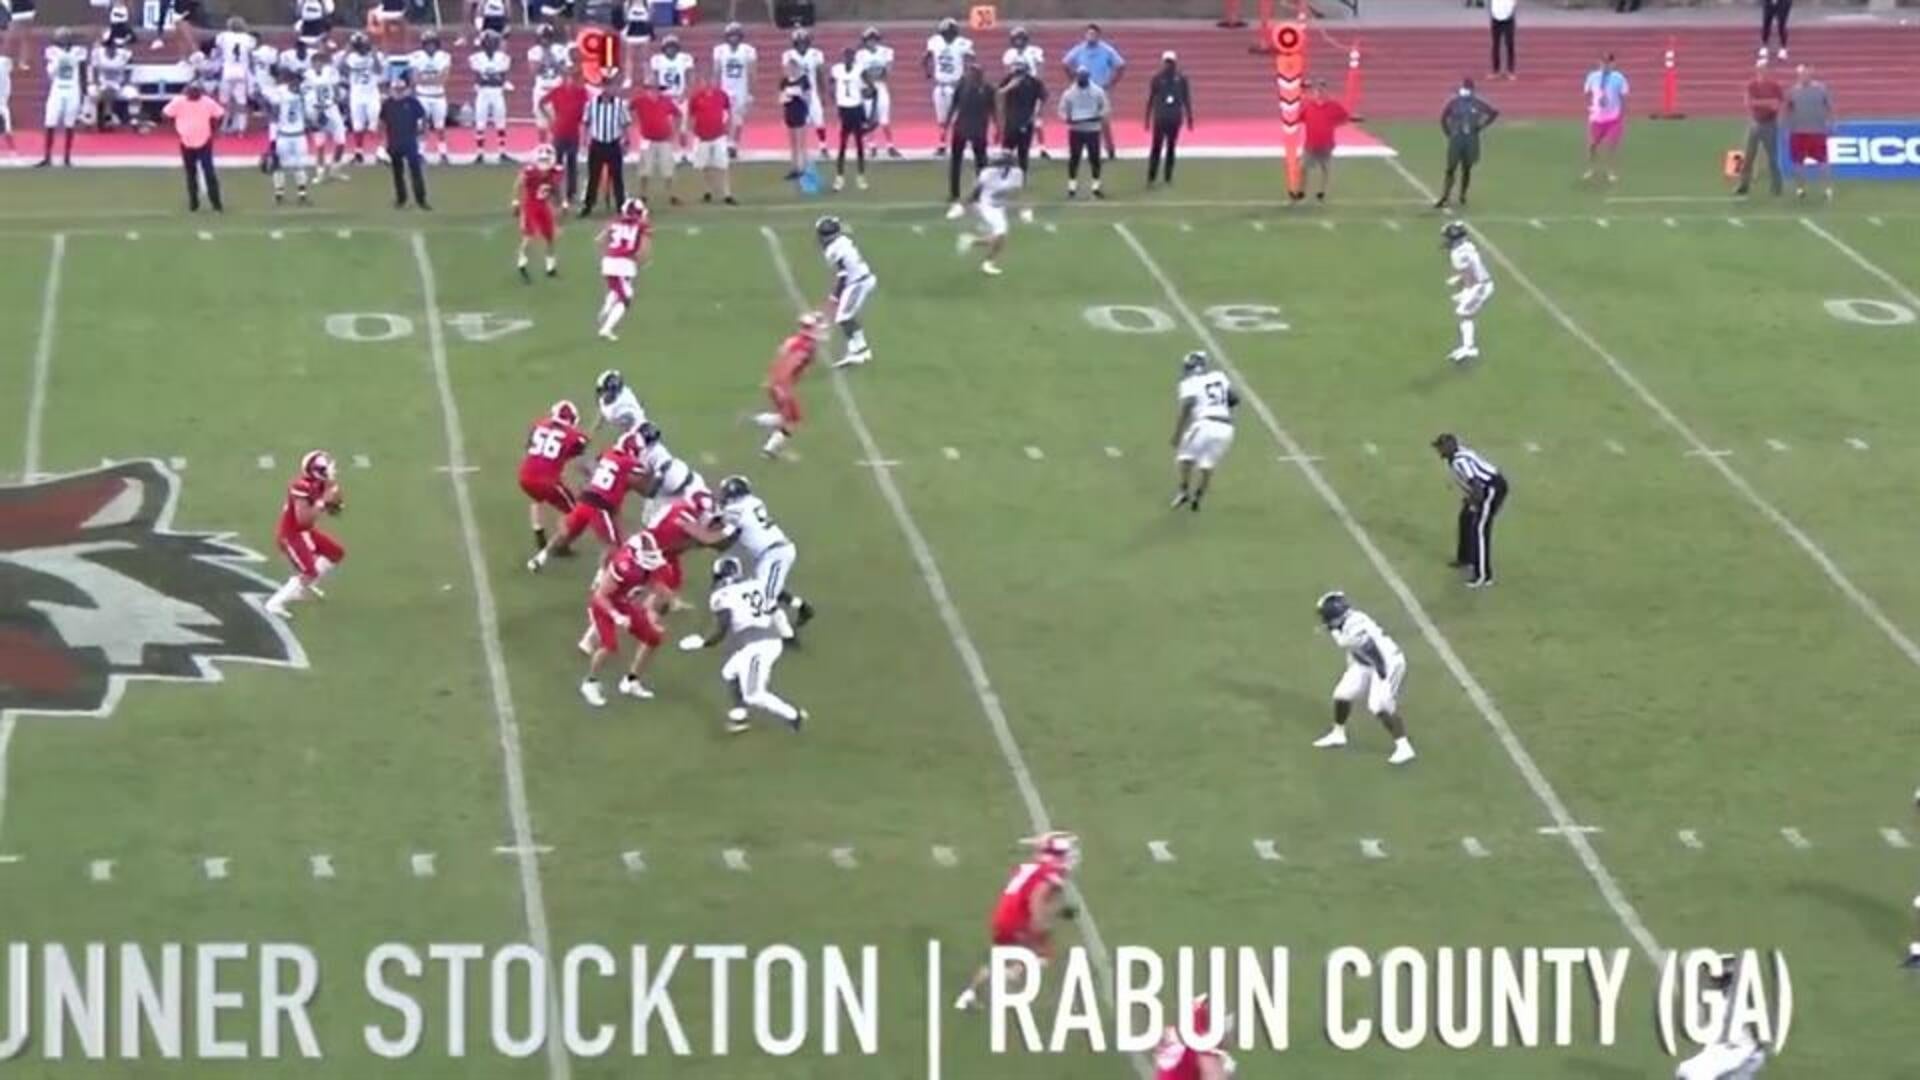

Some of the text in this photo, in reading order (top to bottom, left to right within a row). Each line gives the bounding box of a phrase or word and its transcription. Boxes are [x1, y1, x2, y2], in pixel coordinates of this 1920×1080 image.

[1826, 136, 1920, 165] EIC
[608, 223, 639, 251] 34
[529, 427, 566, 458] 56
